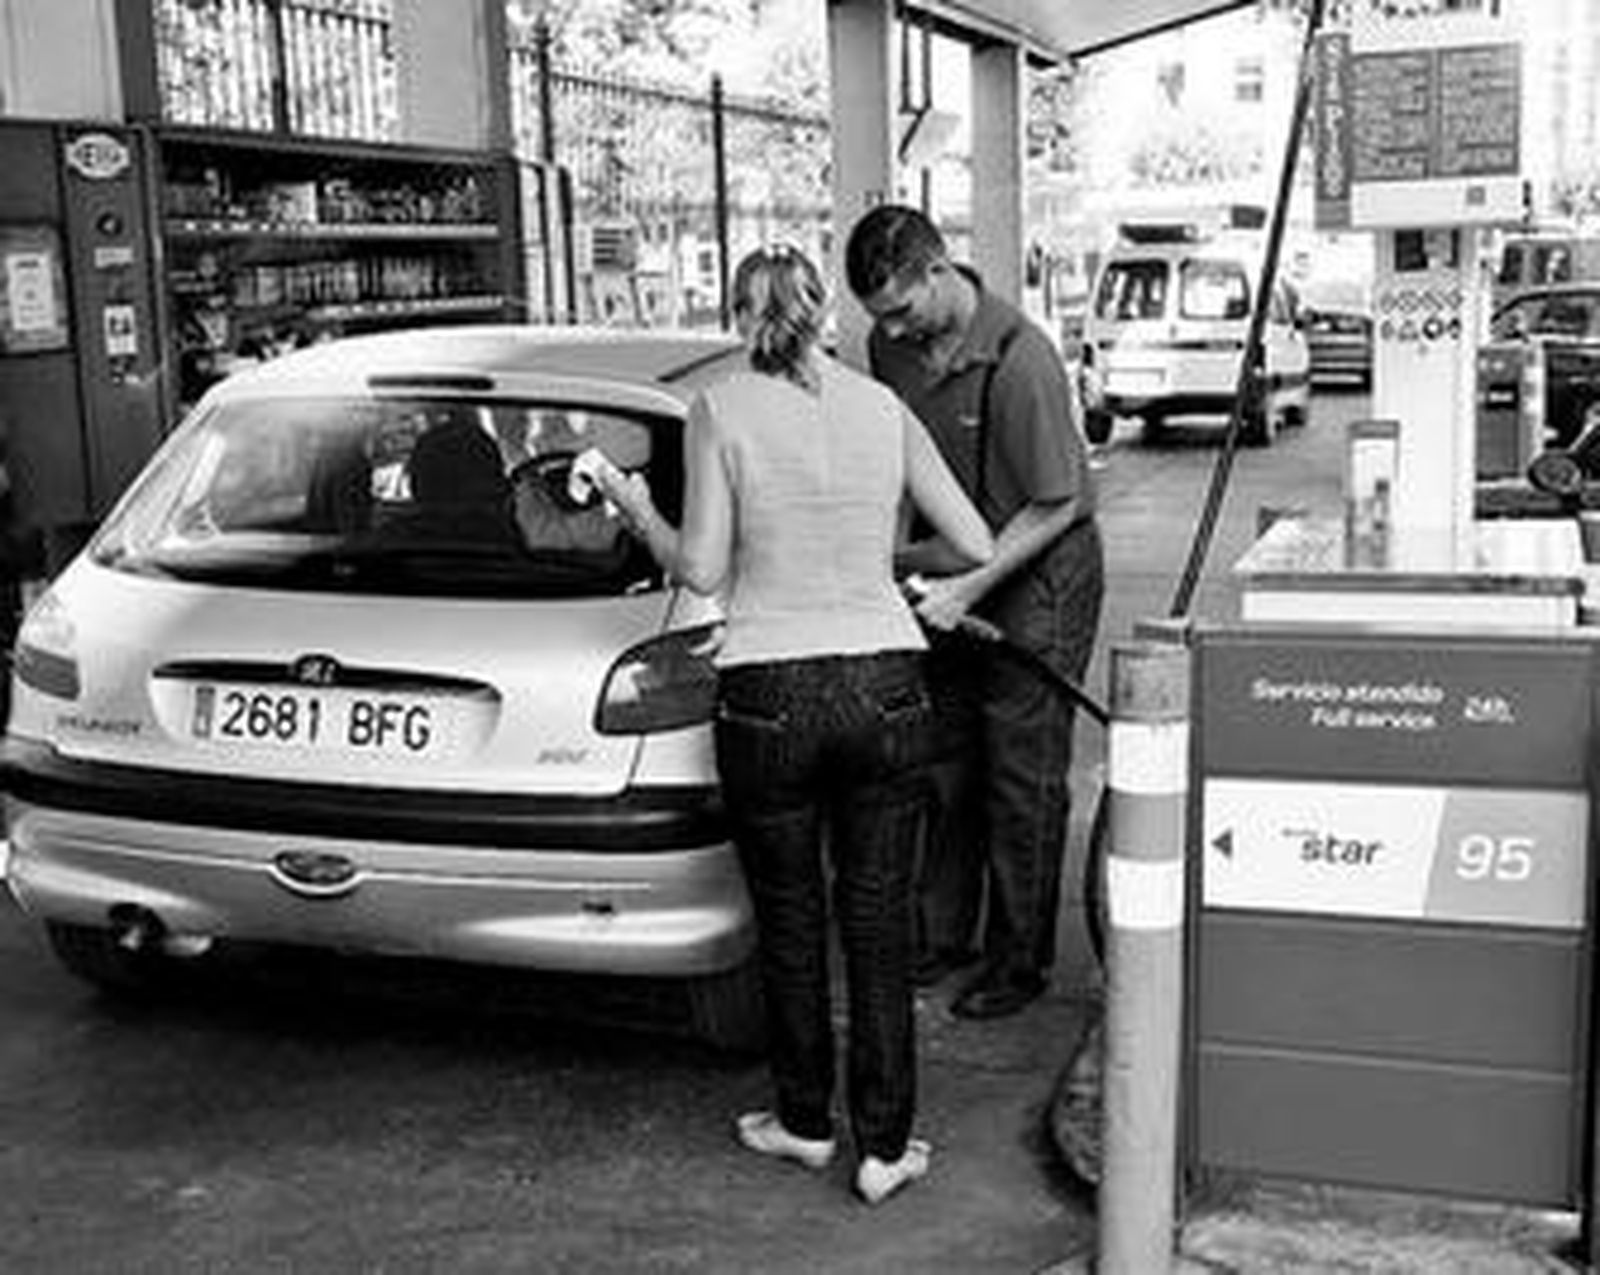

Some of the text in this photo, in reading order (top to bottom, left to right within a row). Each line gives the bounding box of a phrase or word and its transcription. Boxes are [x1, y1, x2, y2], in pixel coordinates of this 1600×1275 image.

[221, 691, 431, 752] 2681 BFG
[1299, 832, 1536, 882] star 95
